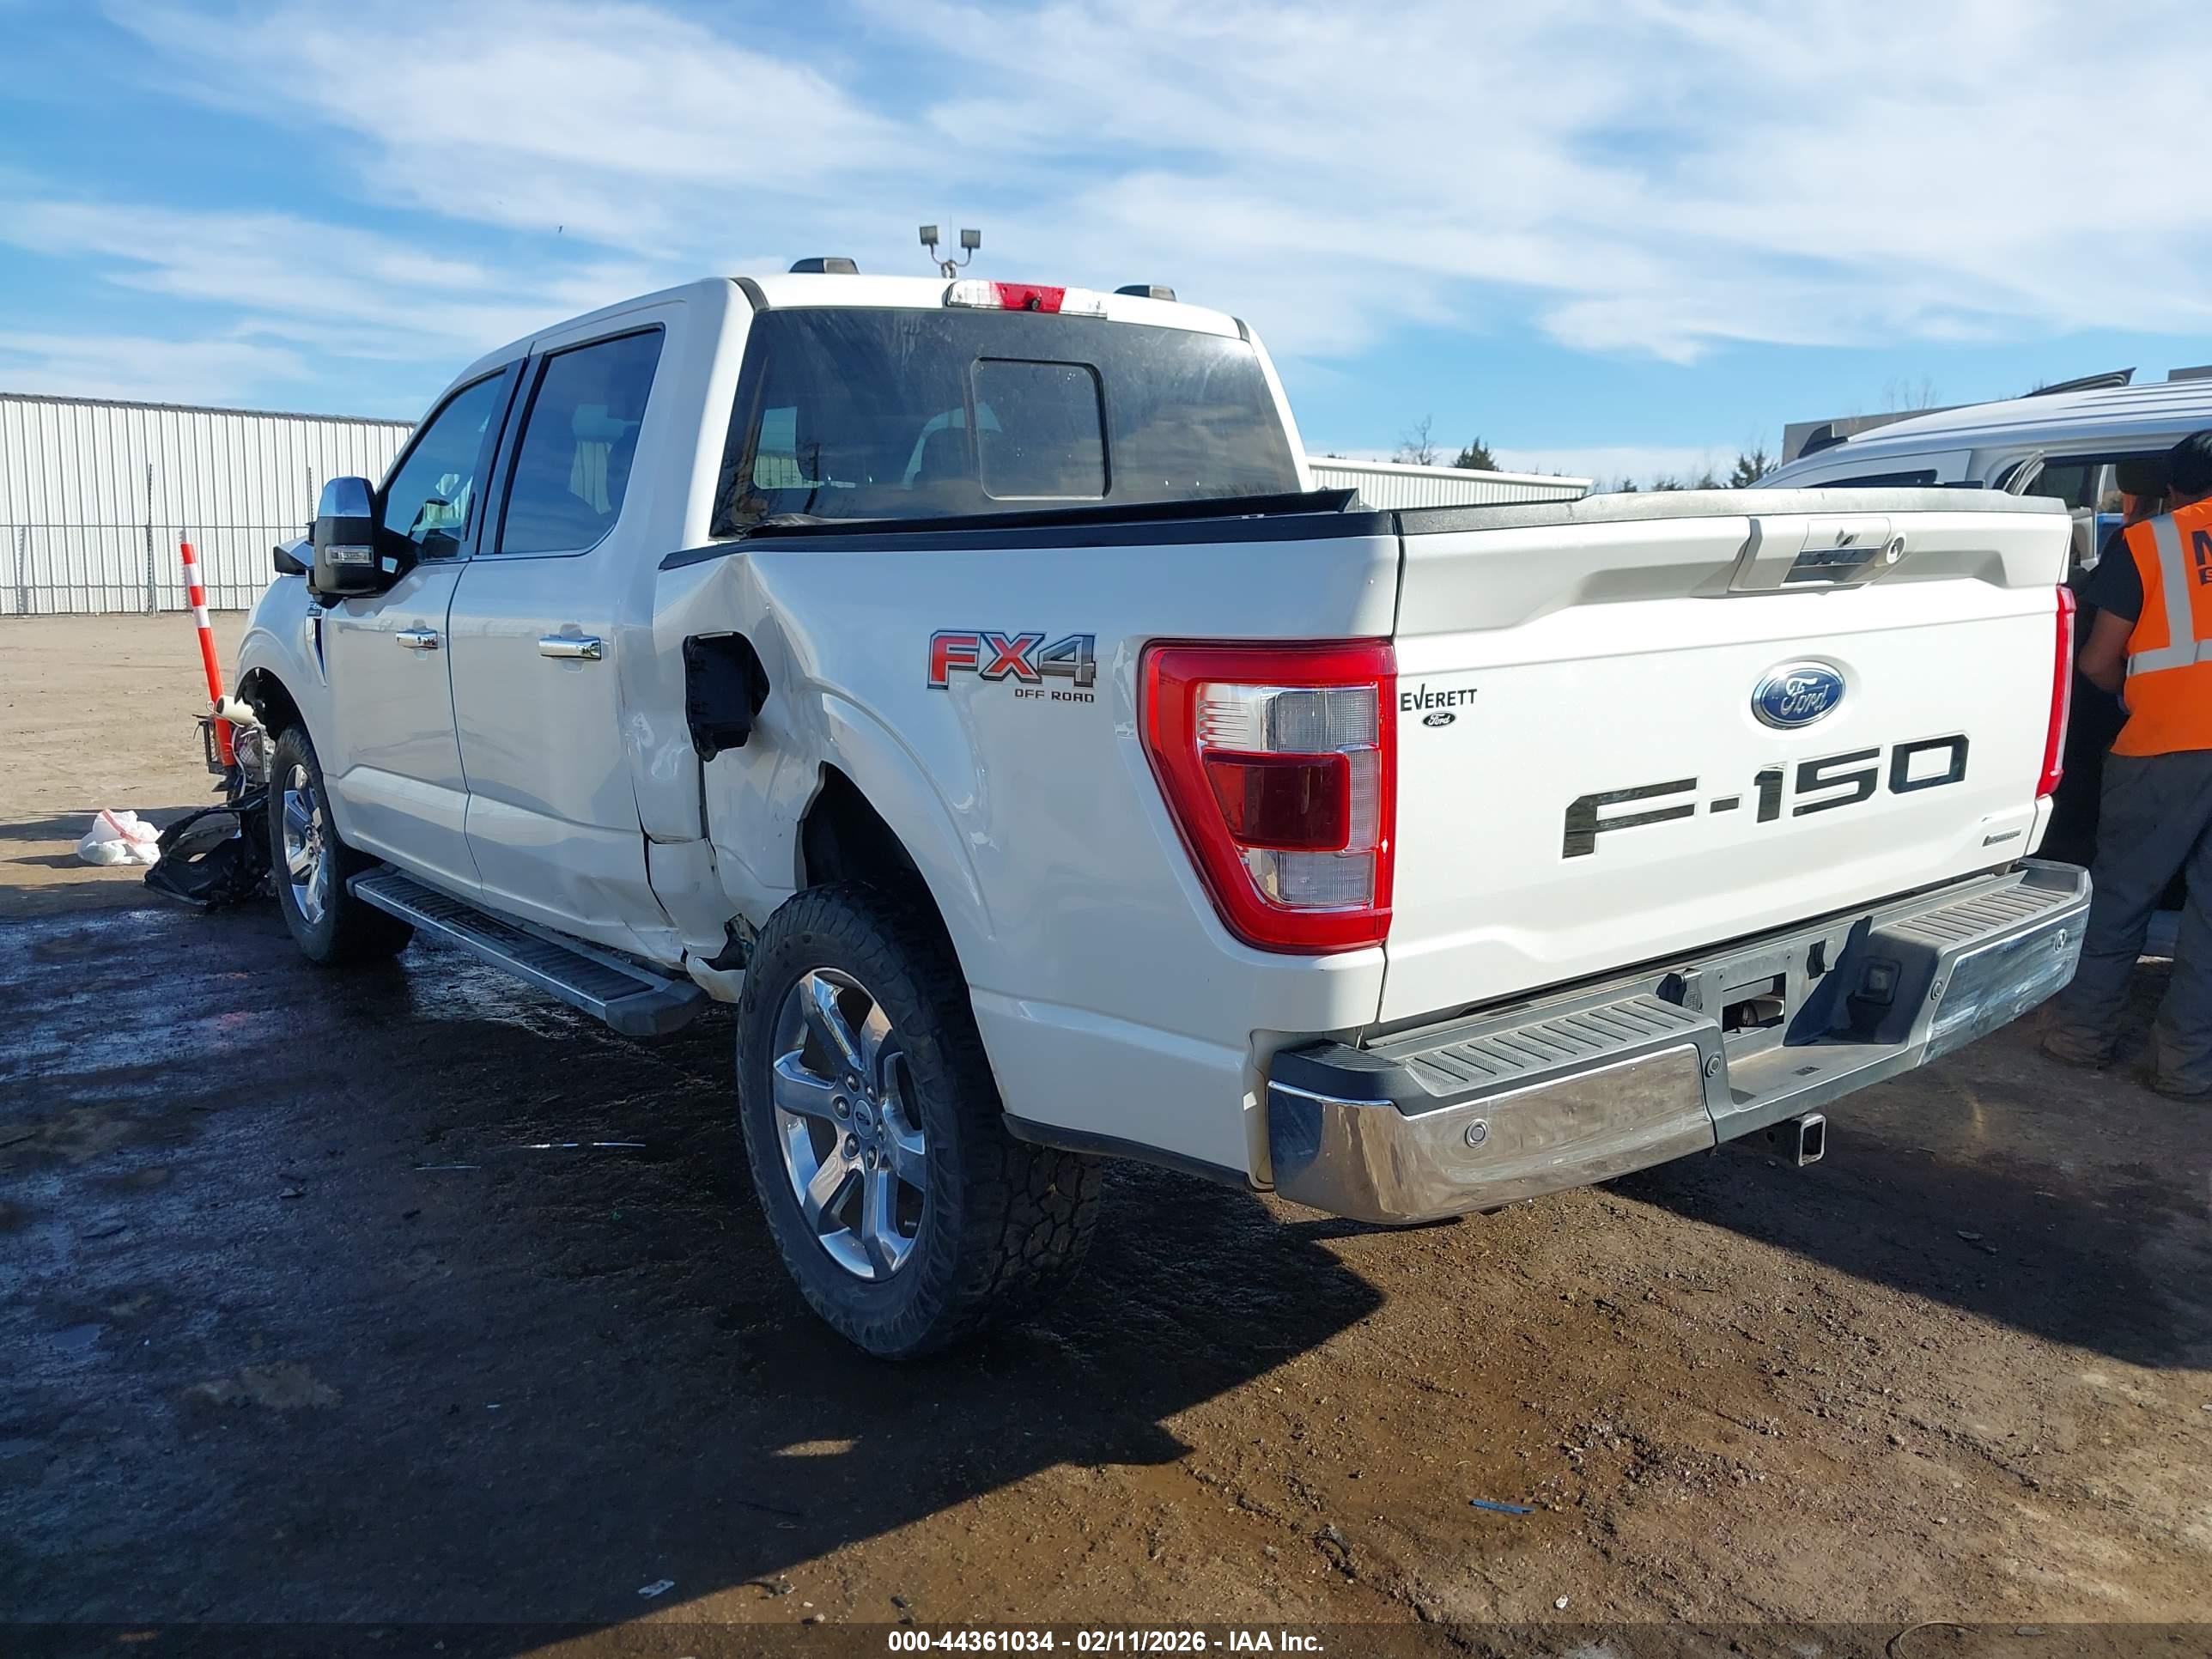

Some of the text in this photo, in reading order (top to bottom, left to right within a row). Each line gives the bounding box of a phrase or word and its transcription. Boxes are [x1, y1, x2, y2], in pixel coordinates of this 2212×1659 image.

[927, 630, 1097, 690] FX4
[1015, 689, 1095, 703] OFF ROAD
[1400, 683, 1478, 712] EVERETT
[1780, 678, 1830, 716] Ford
[1427, 713, 1451, 726] Ford
[1561, 733, 1970, 860] F-150
